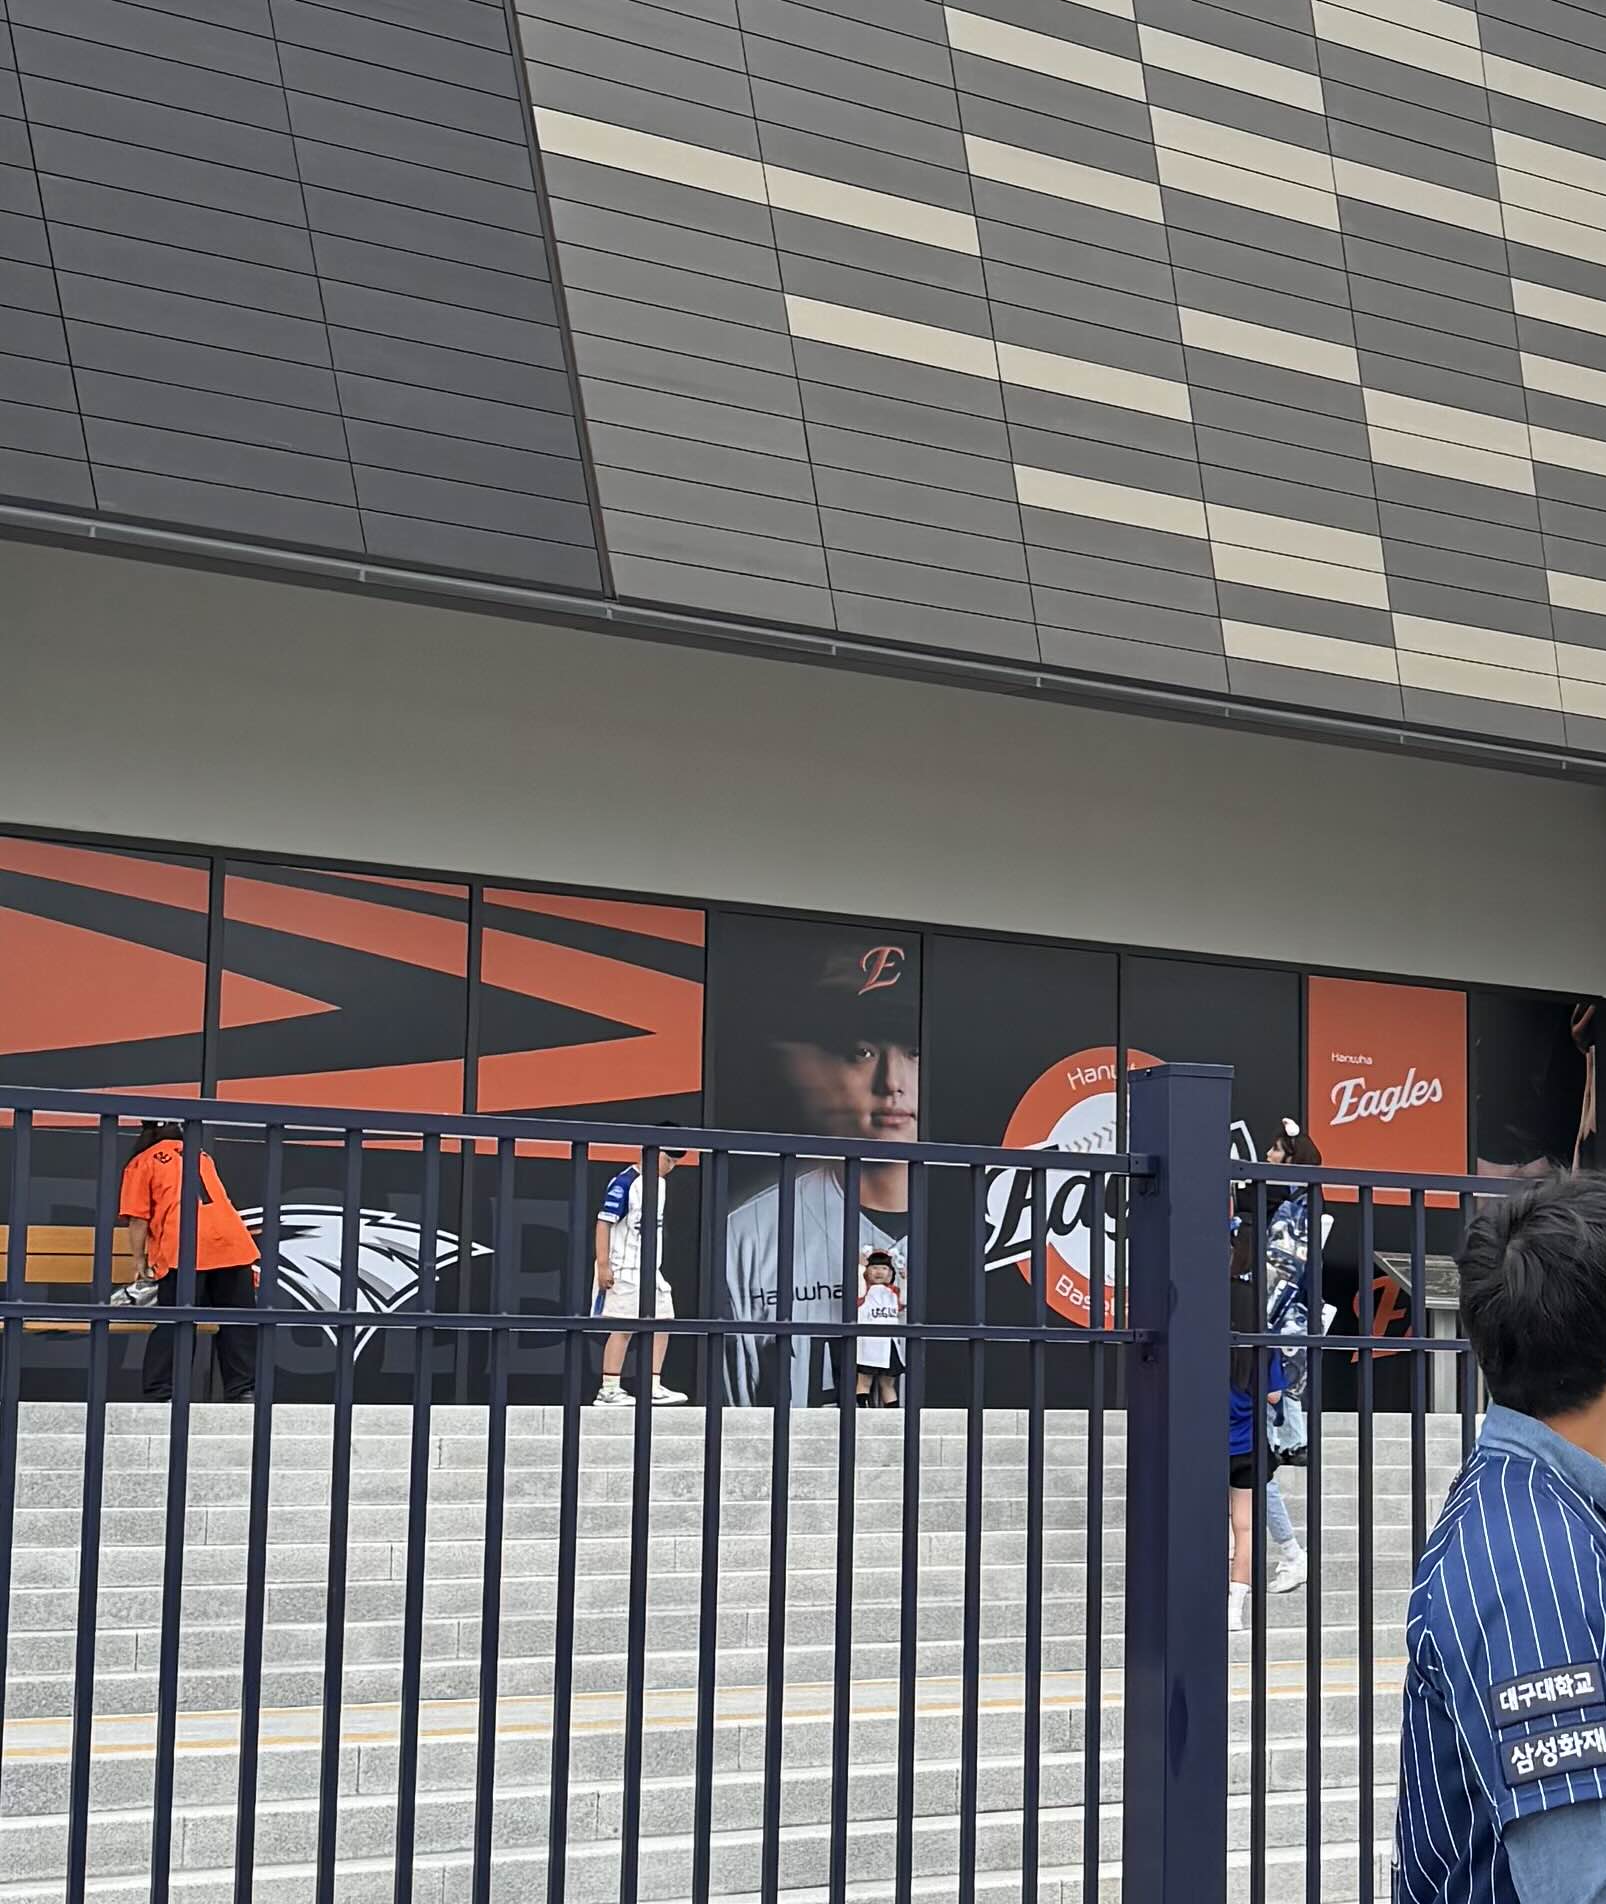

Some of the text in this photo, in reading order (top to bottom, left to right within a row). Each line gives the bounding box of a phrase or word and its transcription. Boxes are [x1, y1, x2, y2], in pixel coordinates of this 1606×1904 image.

[1331, 1051, 1373, 1066] Hanwha
[1329, 1067, 1443, 1127] Eagles
[750, 1280, 844, 1306] Hawha
[1499, 1671, 1595, 1711] 대구대학교
